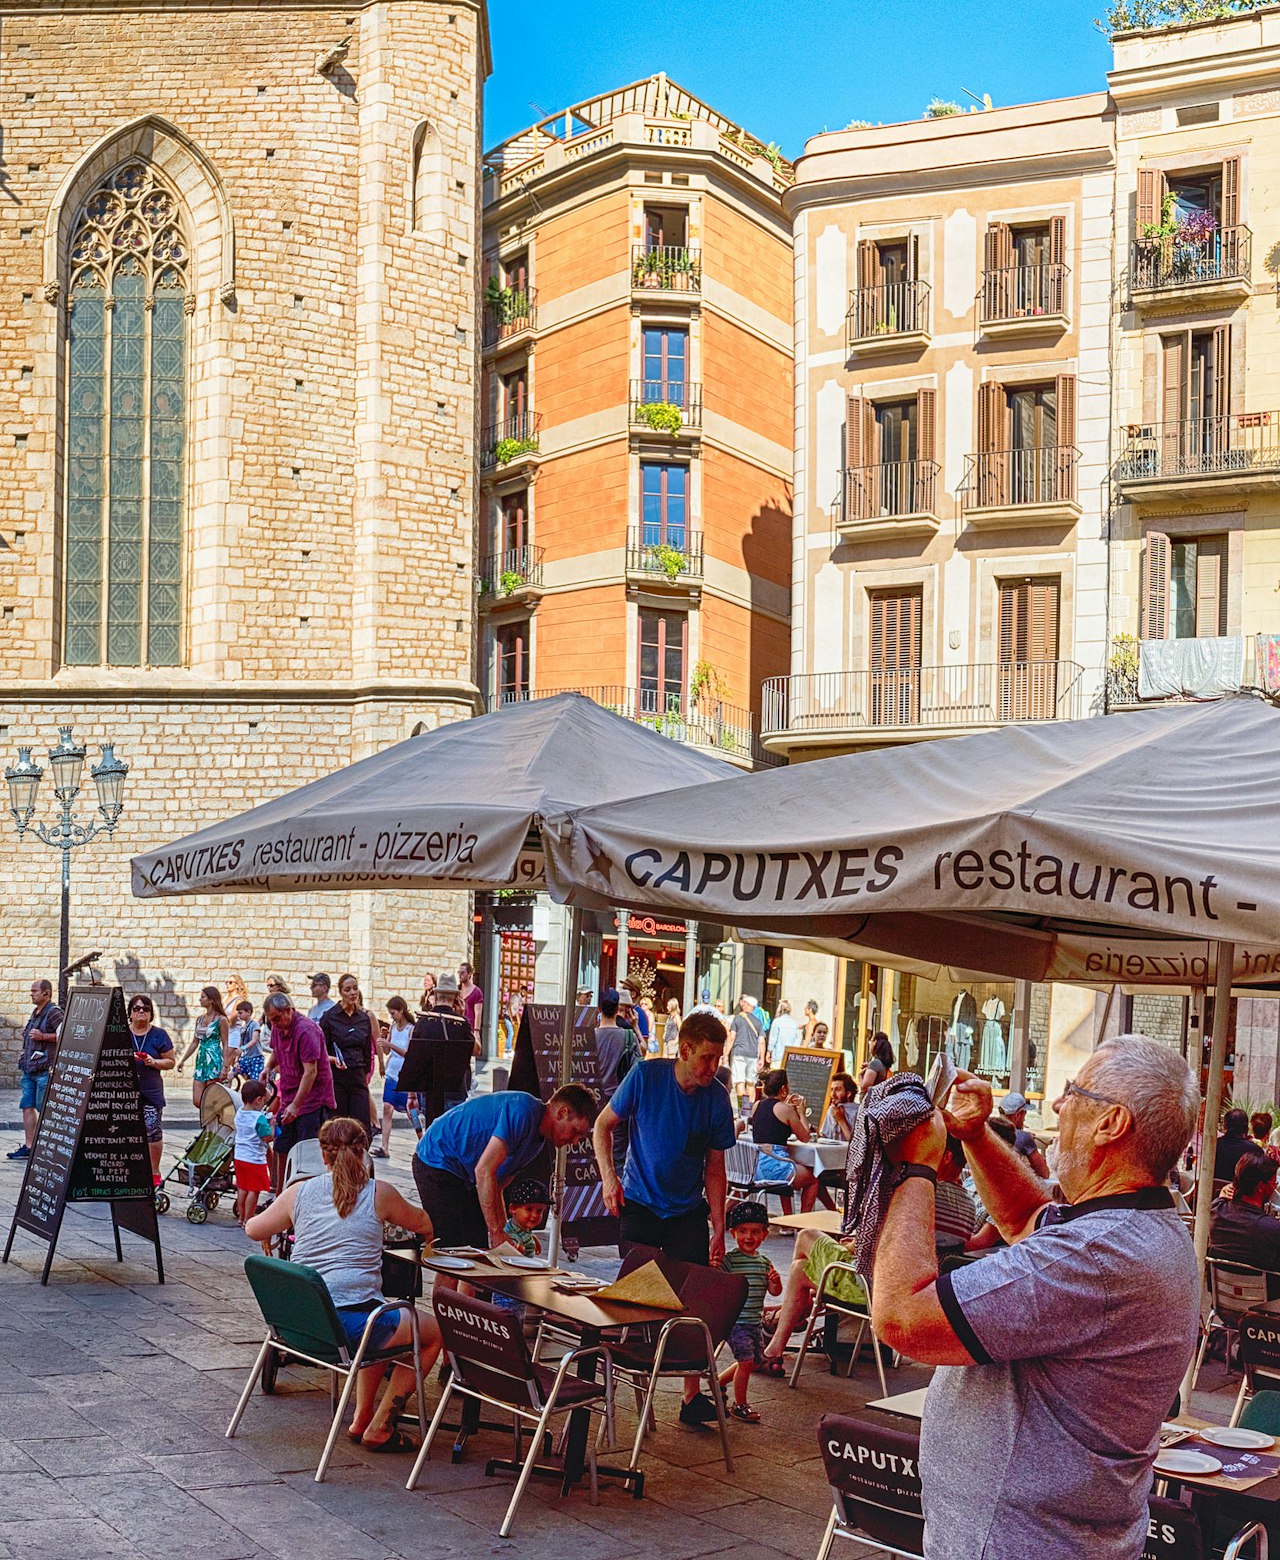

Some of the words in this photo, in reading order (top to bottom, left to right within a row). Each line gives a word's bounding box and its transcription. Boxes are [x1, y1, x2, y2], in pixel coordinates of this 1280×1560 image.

[150, 839, 245, 886] CAPUTXES
[253, 826, 357, 867] restaurant
[373, 822, 479, 869] pizzeria
[625, 845, 904, 901] CAPUTXES
[934, 840, 1220, 920] restaurant
[90, 1091, 116, 1099] MARTIN
[88, 1100, 110, 1110] LONDON
[112, 1102, 124, 1110] DRY
[124, 1100, 138, 1110] GIN
[86, 1113, 109, 1121] BOMBAY
[127, 1136, 144, 1144] TREE
[92, 1167, 104, 1175] TIO
[95, 1175, 128, 1183] MARTINI
[438, 1303, 511, 1340] CAPUTXES
[828, 1440, 921, 1478] CAPUTX
[849, 1473, 889, 1491] restaurant
